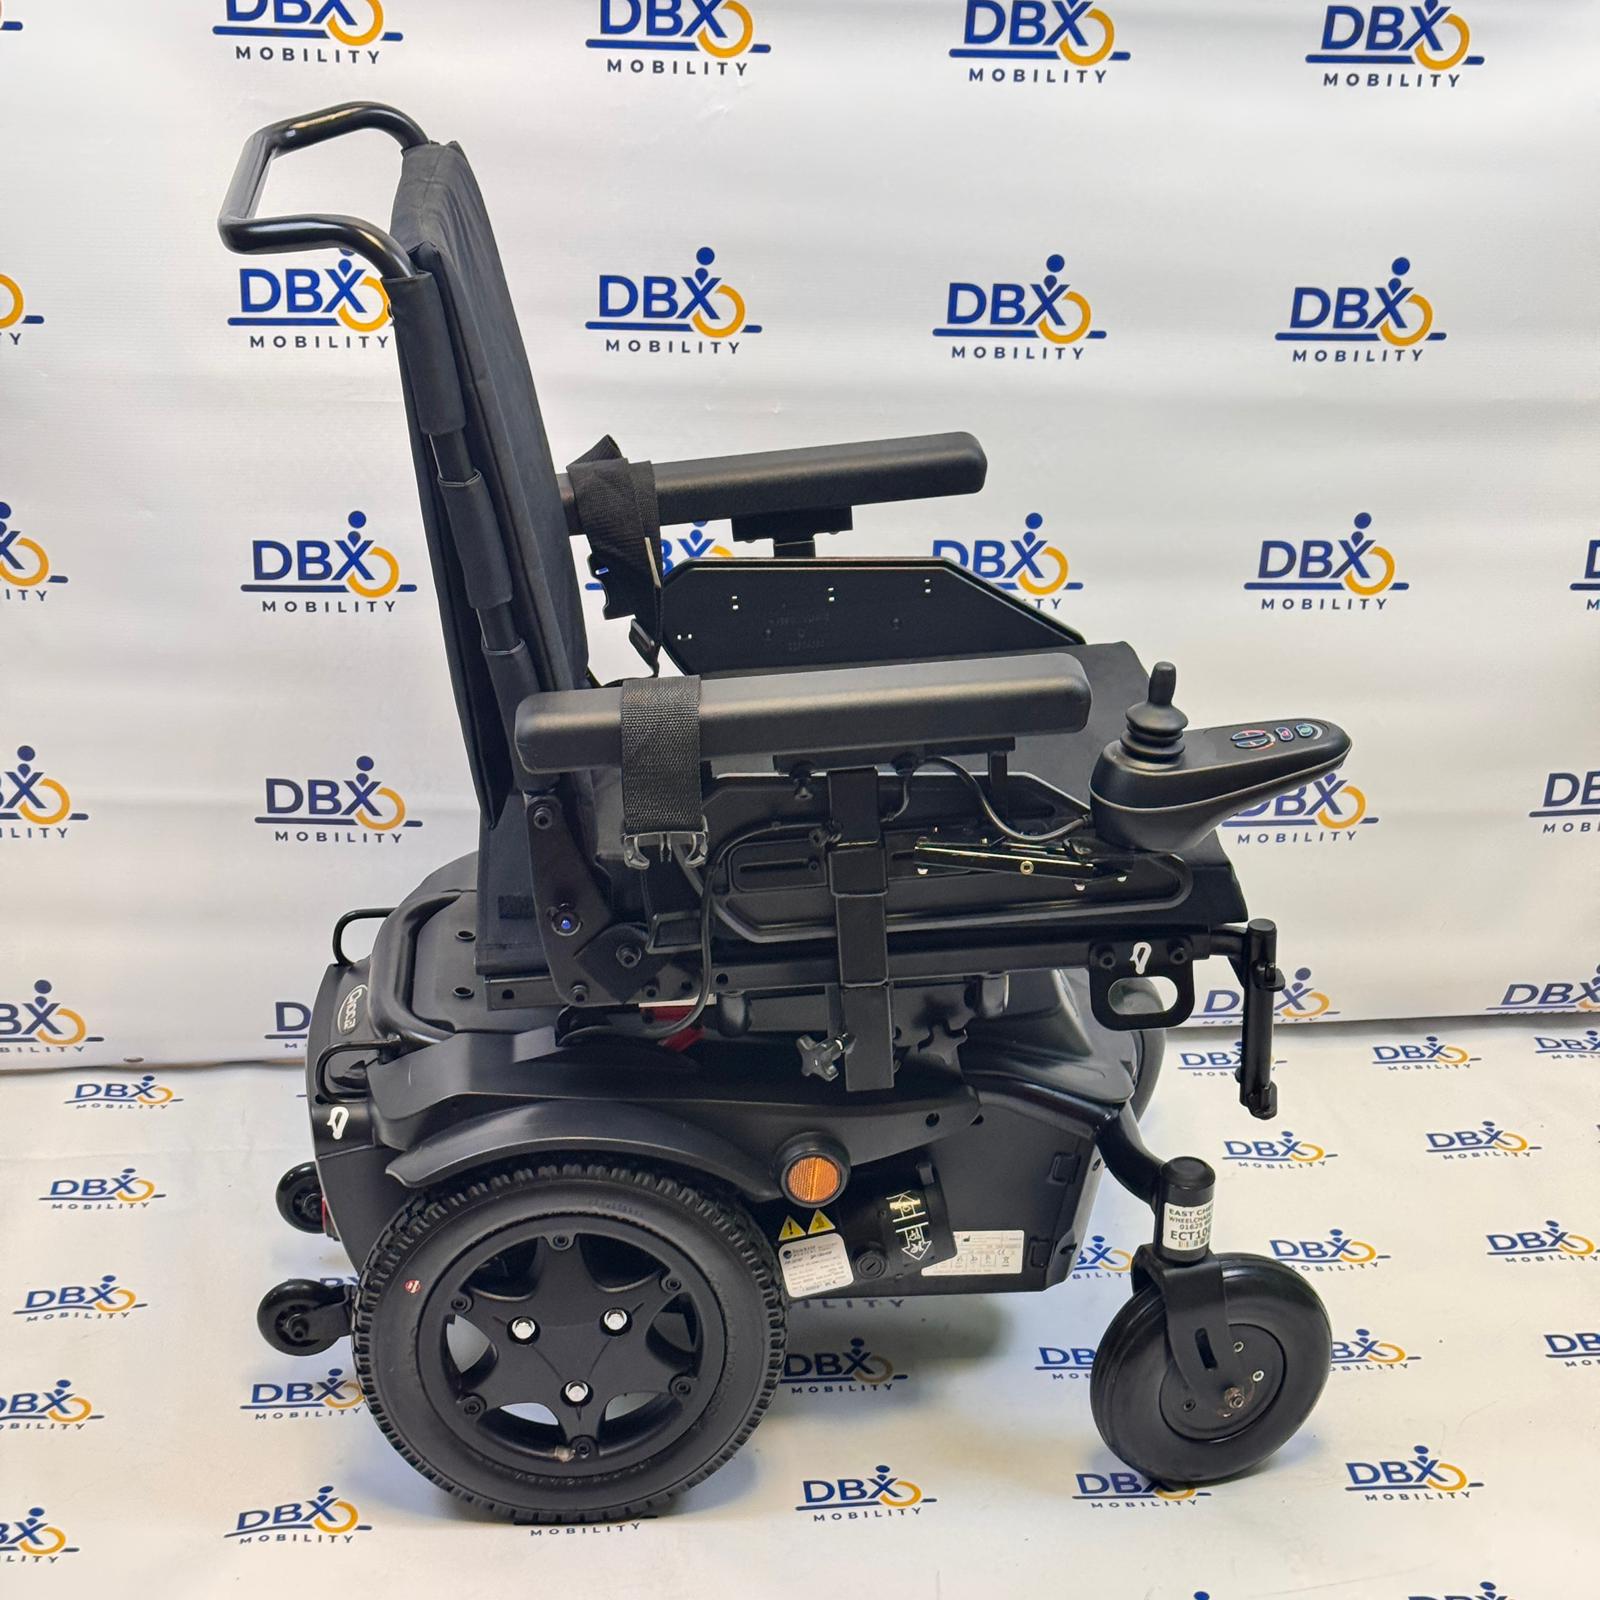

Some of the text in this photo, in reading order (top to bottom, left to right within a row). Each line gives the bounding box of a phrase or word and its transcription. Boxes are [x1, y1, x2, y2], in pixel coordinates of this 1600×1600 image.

[226, 0, 357, 26] DBX
[600, 0, 727, 38] DBX
[964, 0, 1093, 46] DBX
[1321, 5, 1451, 51] DBX
[236, 46, 379, 64] MOBILITY
[607, 59, 747, 76] MOBILITY
[969, 68, 1106, 83] MOBILITY
[1324, 73, 1460, 87] MOBILITY
[240, 269, 367, 313] DBX
[599, 275, 721, 320] DBX
[947, 283, 1070, 326] DBX
[1290, 287, 1414, 329] DBX
[250, 336, 388, 348] MOBILITY
[606, 339, 739, 354] MOBILITY
[952, 346, 1083, 360] MOBILITY
[1293, 349, 1423, 362] MOBILITY
[253, 540, 375, 581] DBX
[1258, 540, 1375, 578] DBX
[262, 601, 395, 612] MOBILITY
[1262, 599, 1387, 610] MOBILITY
[266, 778, 382, 816] DBX
[1240, 778, 1347, 817] BX
[1543, 771, 1600, 807] DB
[275, 832, 401, 843] MOBILITY
[1238, 831, 1356, 844] MOBILITY
[0, 1003, 63, 1035] BX
[1373, 1045, 1453, 1060] DBX
[75, 1084, 157, 1098] DBX
[1426, 1130, 1511, 1148] DBX
[1224, 1141, 1308, 1156] DBX
[1443, 1151, 1530, 1160] MOBILITY
[1238, 1161, 1326, 1169] MOBILITY
[50, 1177, 138, 1196] DBX
[52, 1202, 149, 1210] MOBILITY
[1169, 1208, 1193, 1217] EAST
[1270, 1239, 1359, 1258] DBX
[1486, 1231, 1577, 1250] DBX
[25, 1286, 120, 1308] DBX
[803, 1300, 903, 1308] ILITY
[27, 1312, 129, 1322] MOBILITY
[1331, 1340, 1389, 1358] BX
[1544, 1333, 1600, 1353] DB
[1039, 1347, 1096, 1364] DB
[784, 1353, 874, 1376] DBX
[252, 1380, 348, 1403] DBX
[791, 1383, 892, 1395] MOBILITY
[0, 1393, 74, 1414] BX
[255, 1407, 361, 1419] MOBILITY
[1346, 1460, 1448, 1484] DBX
[803, 1478, 902, 1503] DBX
[1365, 1492, 1470, 1501] MOBILITY
[1091, 1500, 1196, 1508] MOBILITY
[237, 1497, 339, 1530] DBX
[814, 1507, 920, 1522] MOBILITY
[531, 1523, 639, 1536] MOBILITY
[240, 1534, 353, 1544] MOBILITY
